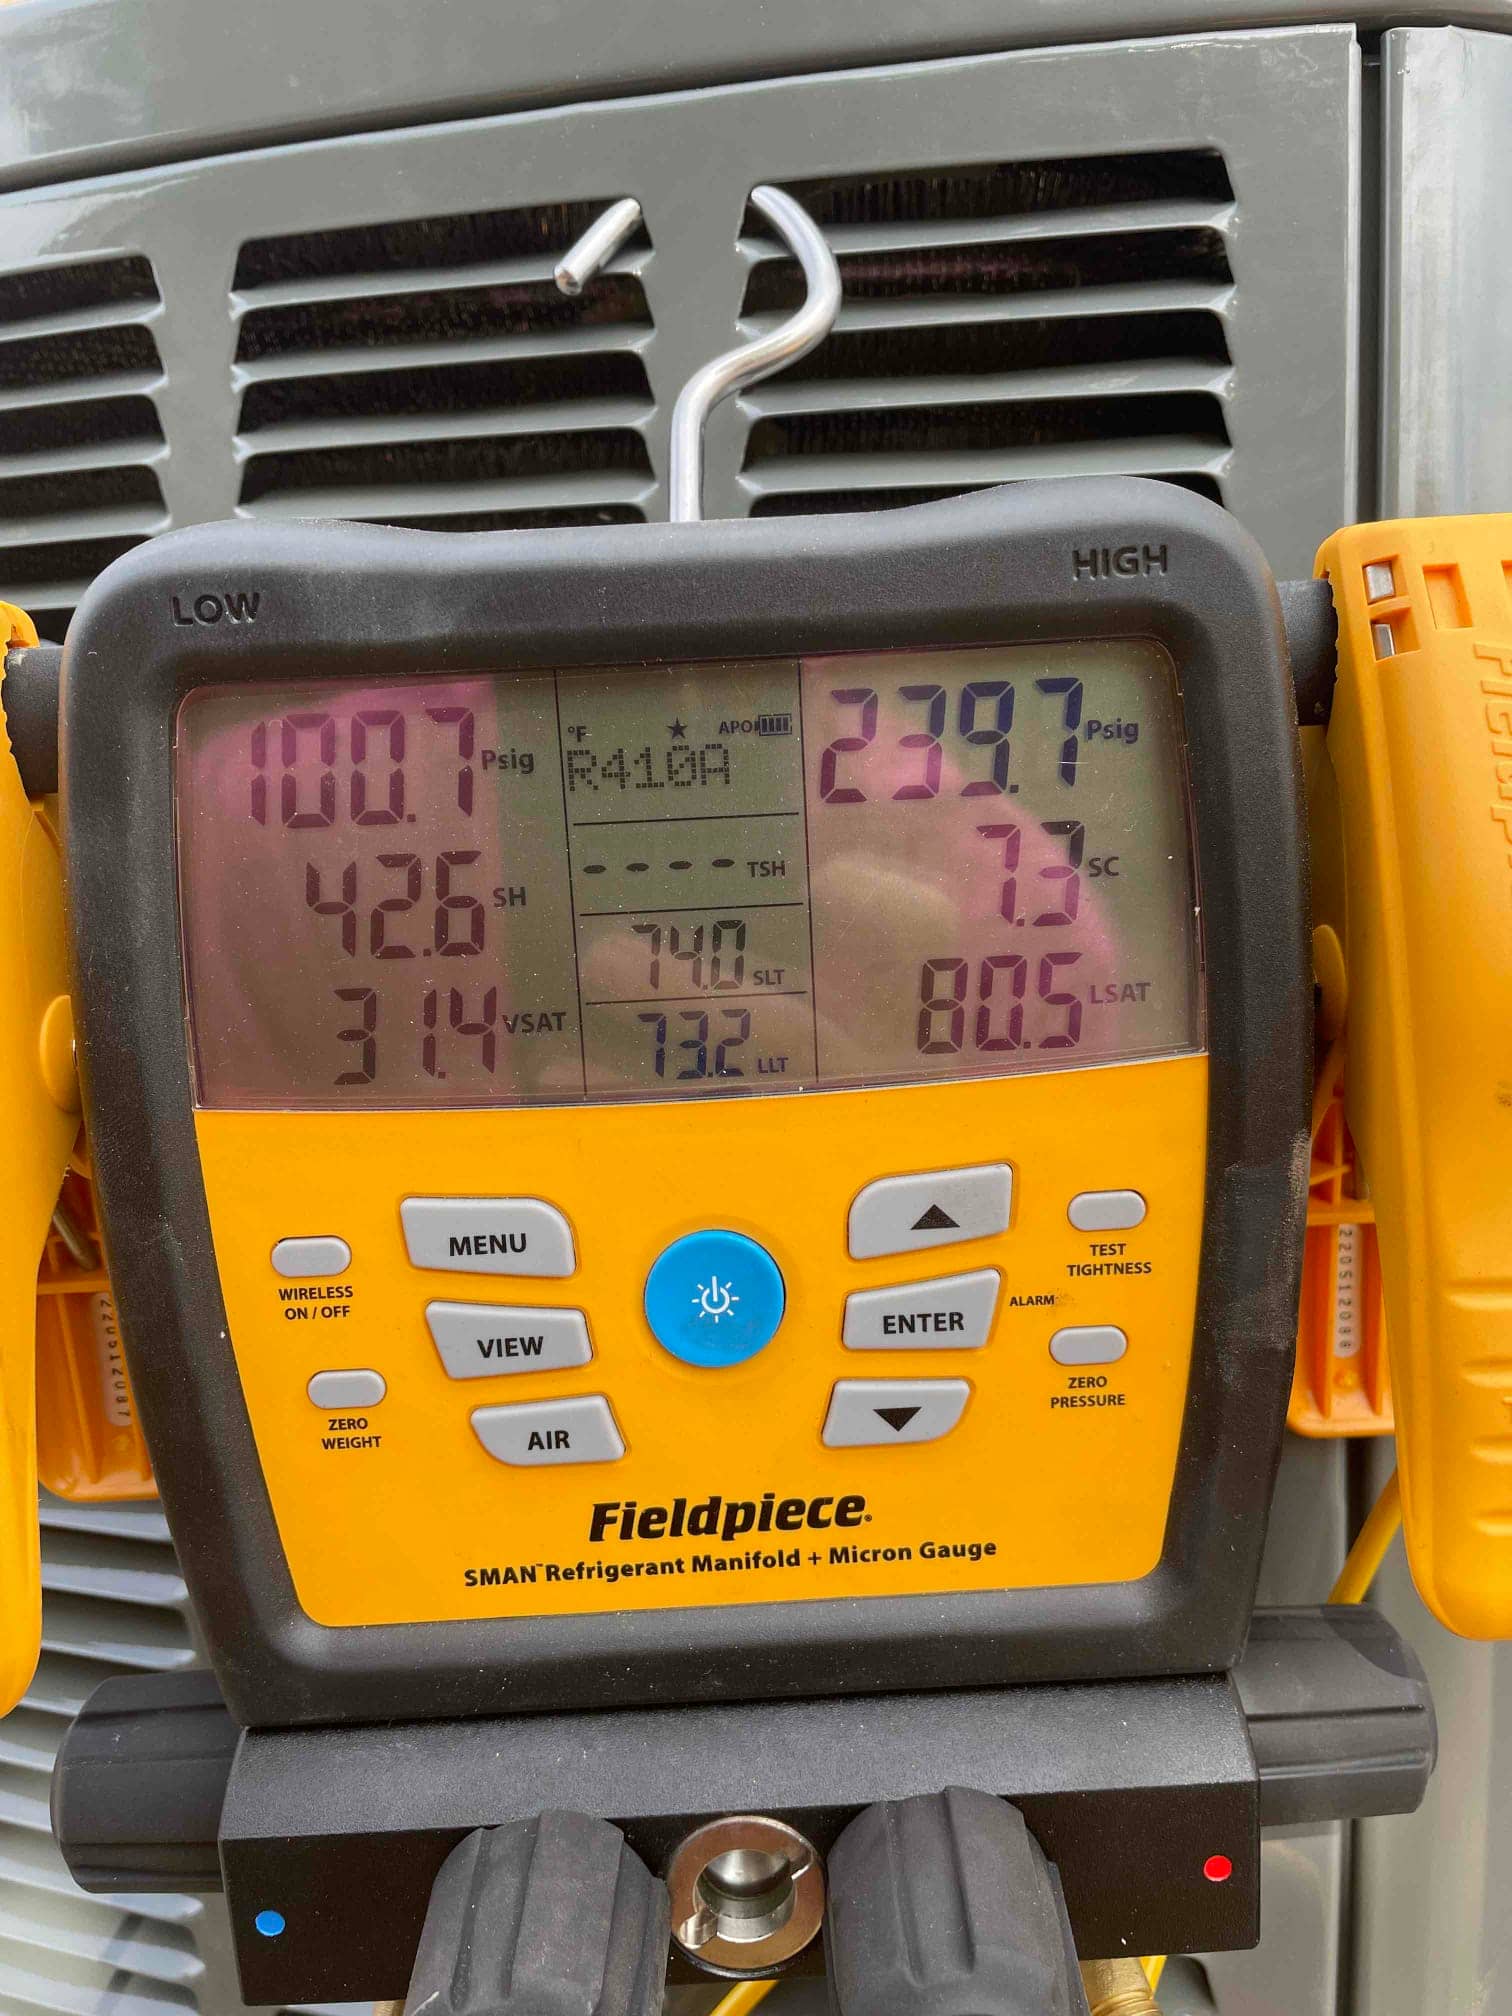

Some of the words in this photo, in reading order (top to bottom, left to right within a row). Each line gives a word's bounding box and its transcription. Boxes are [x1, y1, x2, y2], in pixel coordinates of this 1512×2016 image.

[1071, 544, 1168, 580] HIGH
[172, 592, 260, 627] LOW
[719, 719, 752, 735] APO
[820, 677, 1084, 804] 239.7
[1086, 718, 1139, 745] Psig
[251, 707, 474, 828] 100.7
[481, 749, 535, 774] Psig
[567, 744, 730, 790] R410A
[747, 860, 786, 878] TSH
[976, 820, 1085, 927] 7.3
[1089, 856, 1119, 877] SC
[306, 850, 485, 960] 42.6
[493, 887, 527, 908] SH
[632, 920, 746, 991] 74.0
[753, 969, 785, 986] SLT
[917, 952, 1083, 1054] 80.5
[1089, 982, 1151, 1004] LSAT
[334, 986, 497, 1085] 31.4
[502, 1011, 567, 1034] VSAT
[637, 1009, 751, 1080] 73.2
[758, 1057, 789, 1074] LLT
[449, 1233, 527, 1257] MENU
[1090, 1243, 1127, 1257] TEST
[1066, 1261, 1152, 1277] TIGHTNESS
[278, 1285, 353, 1301] WIRELESS
[1009, 1294, 1055, 1308] ALARM
[284, 1307, 308, 1320] ON
[321, 1305, 350, 1319] OFF
[883, 1311, 965, 1335] ENTER
[477, 1335, 544, 1359] VIEW
[1067, 1376, 1107, 1389] ZERO
[1050, 1394, 1126, 1409] PRESSURE
[328, 1418, 368, 1431] ZERO
[321, 1435, 382, 1450] WEIGHT
[527, 1430, 570, 1451] AIR
[545, 1556, 686, 1584] Refrigerant
[692, 1548, 801, 1573] Manifold
[829, 1543, 913, 1565] Micron
[919, 1539, 998, 1562] Gauge
